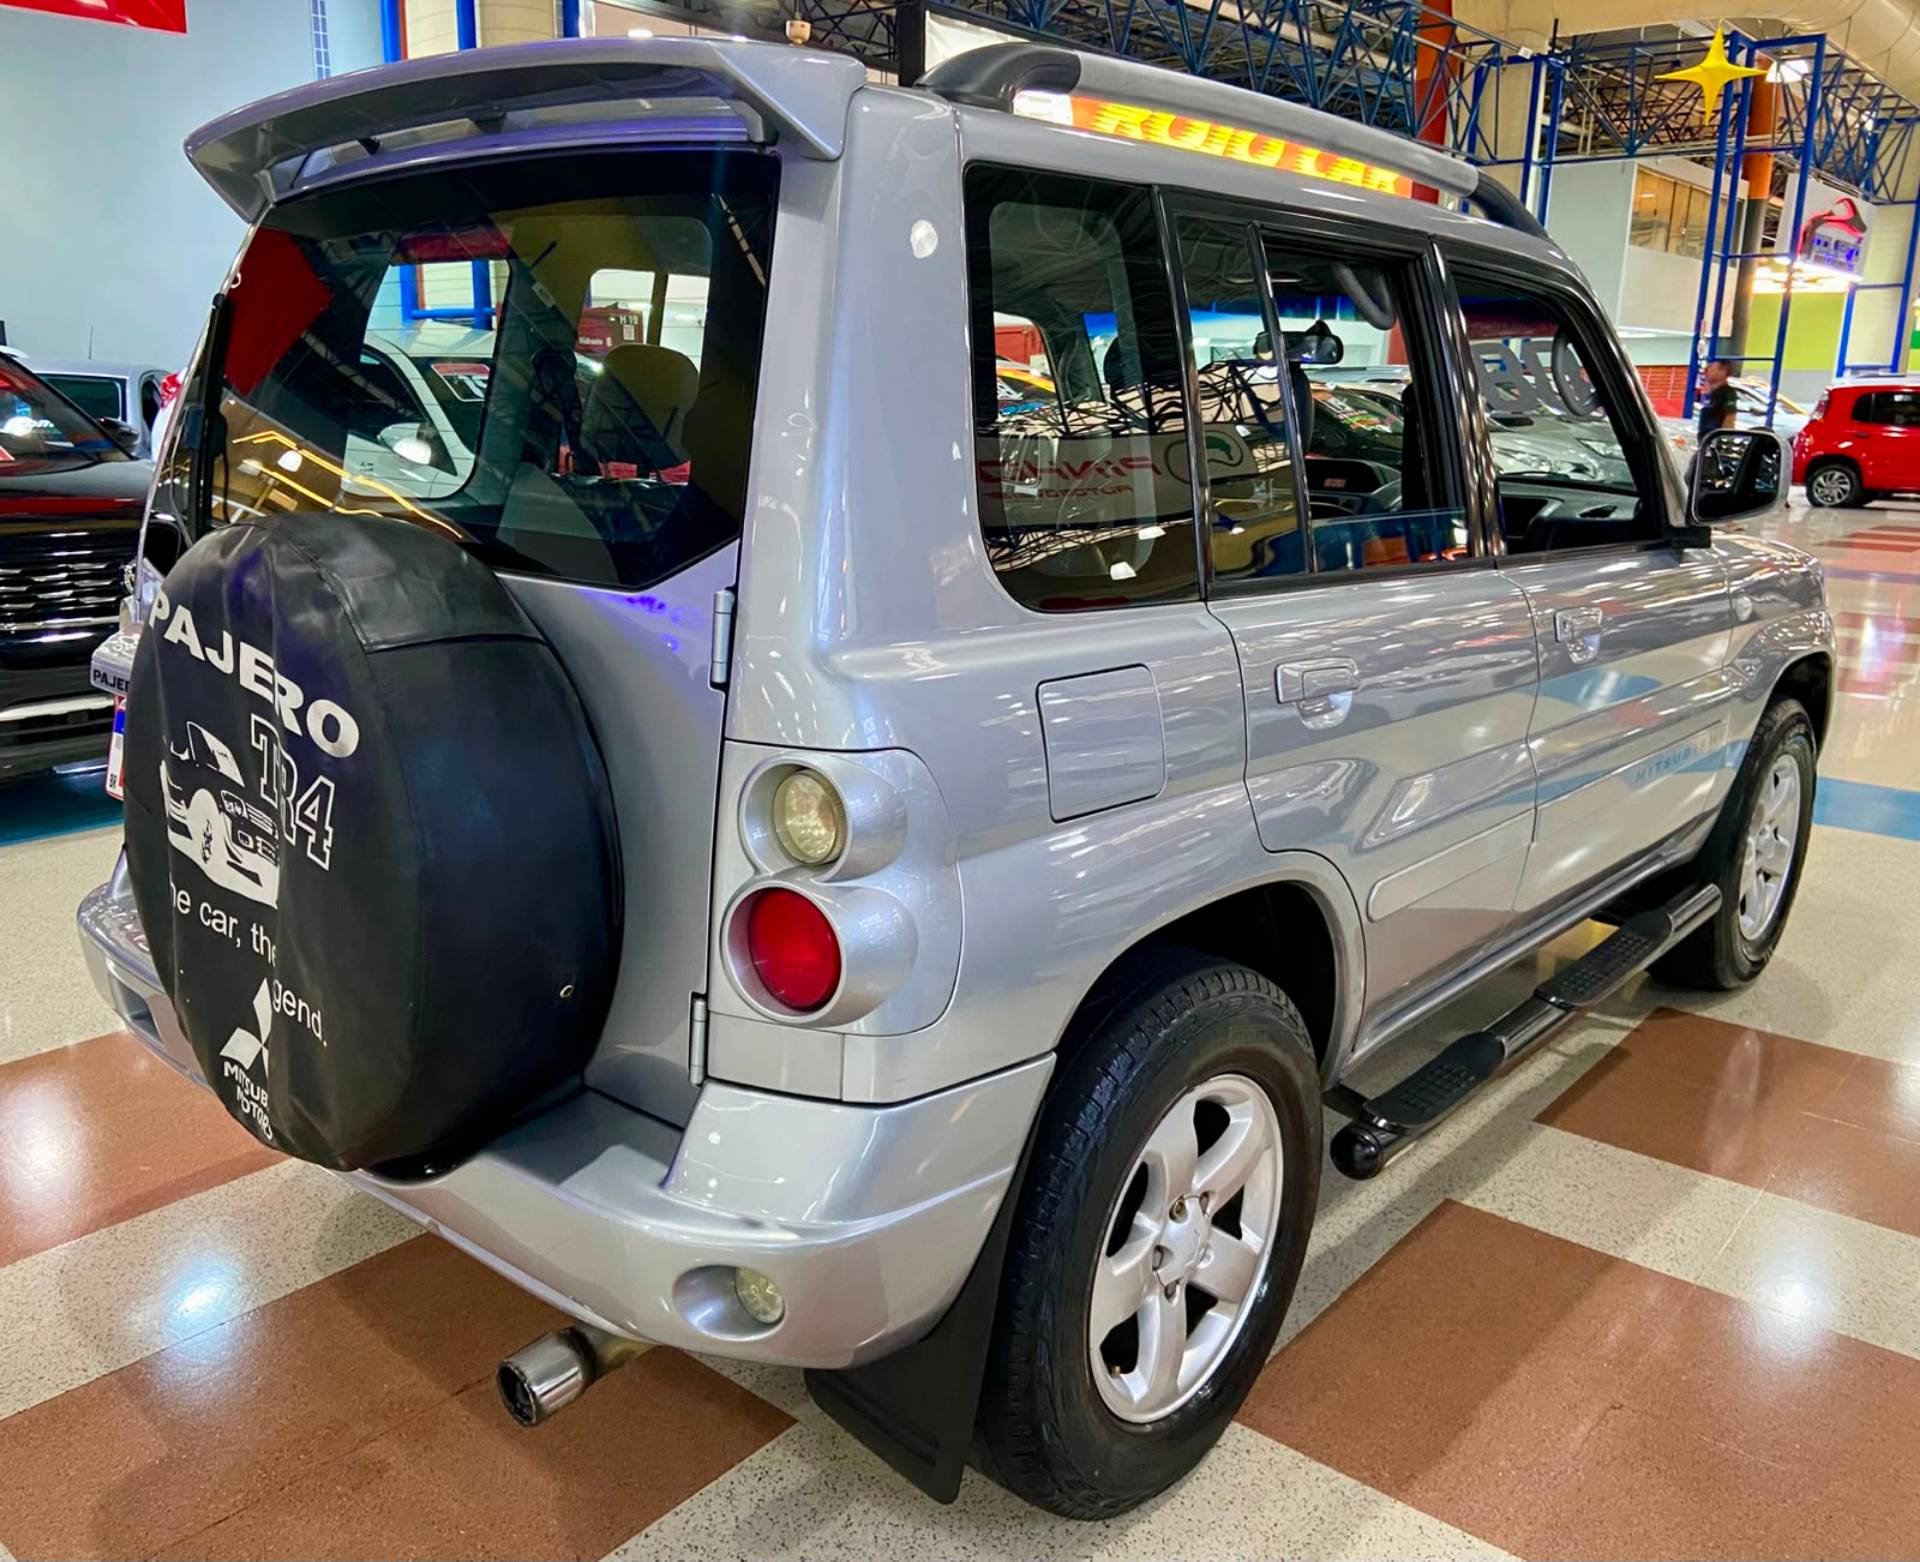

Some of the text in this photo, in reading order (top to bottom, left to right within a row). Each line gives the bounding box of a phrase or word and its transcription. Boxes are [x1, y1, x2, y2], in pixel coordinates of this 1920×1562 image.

[93, 669, 130, 693] PAJE
[149, 591, 360, 759] PAJERO
[199, 901, 241, 949] car,
[223, 1060, 269, 1109] MITSUB
